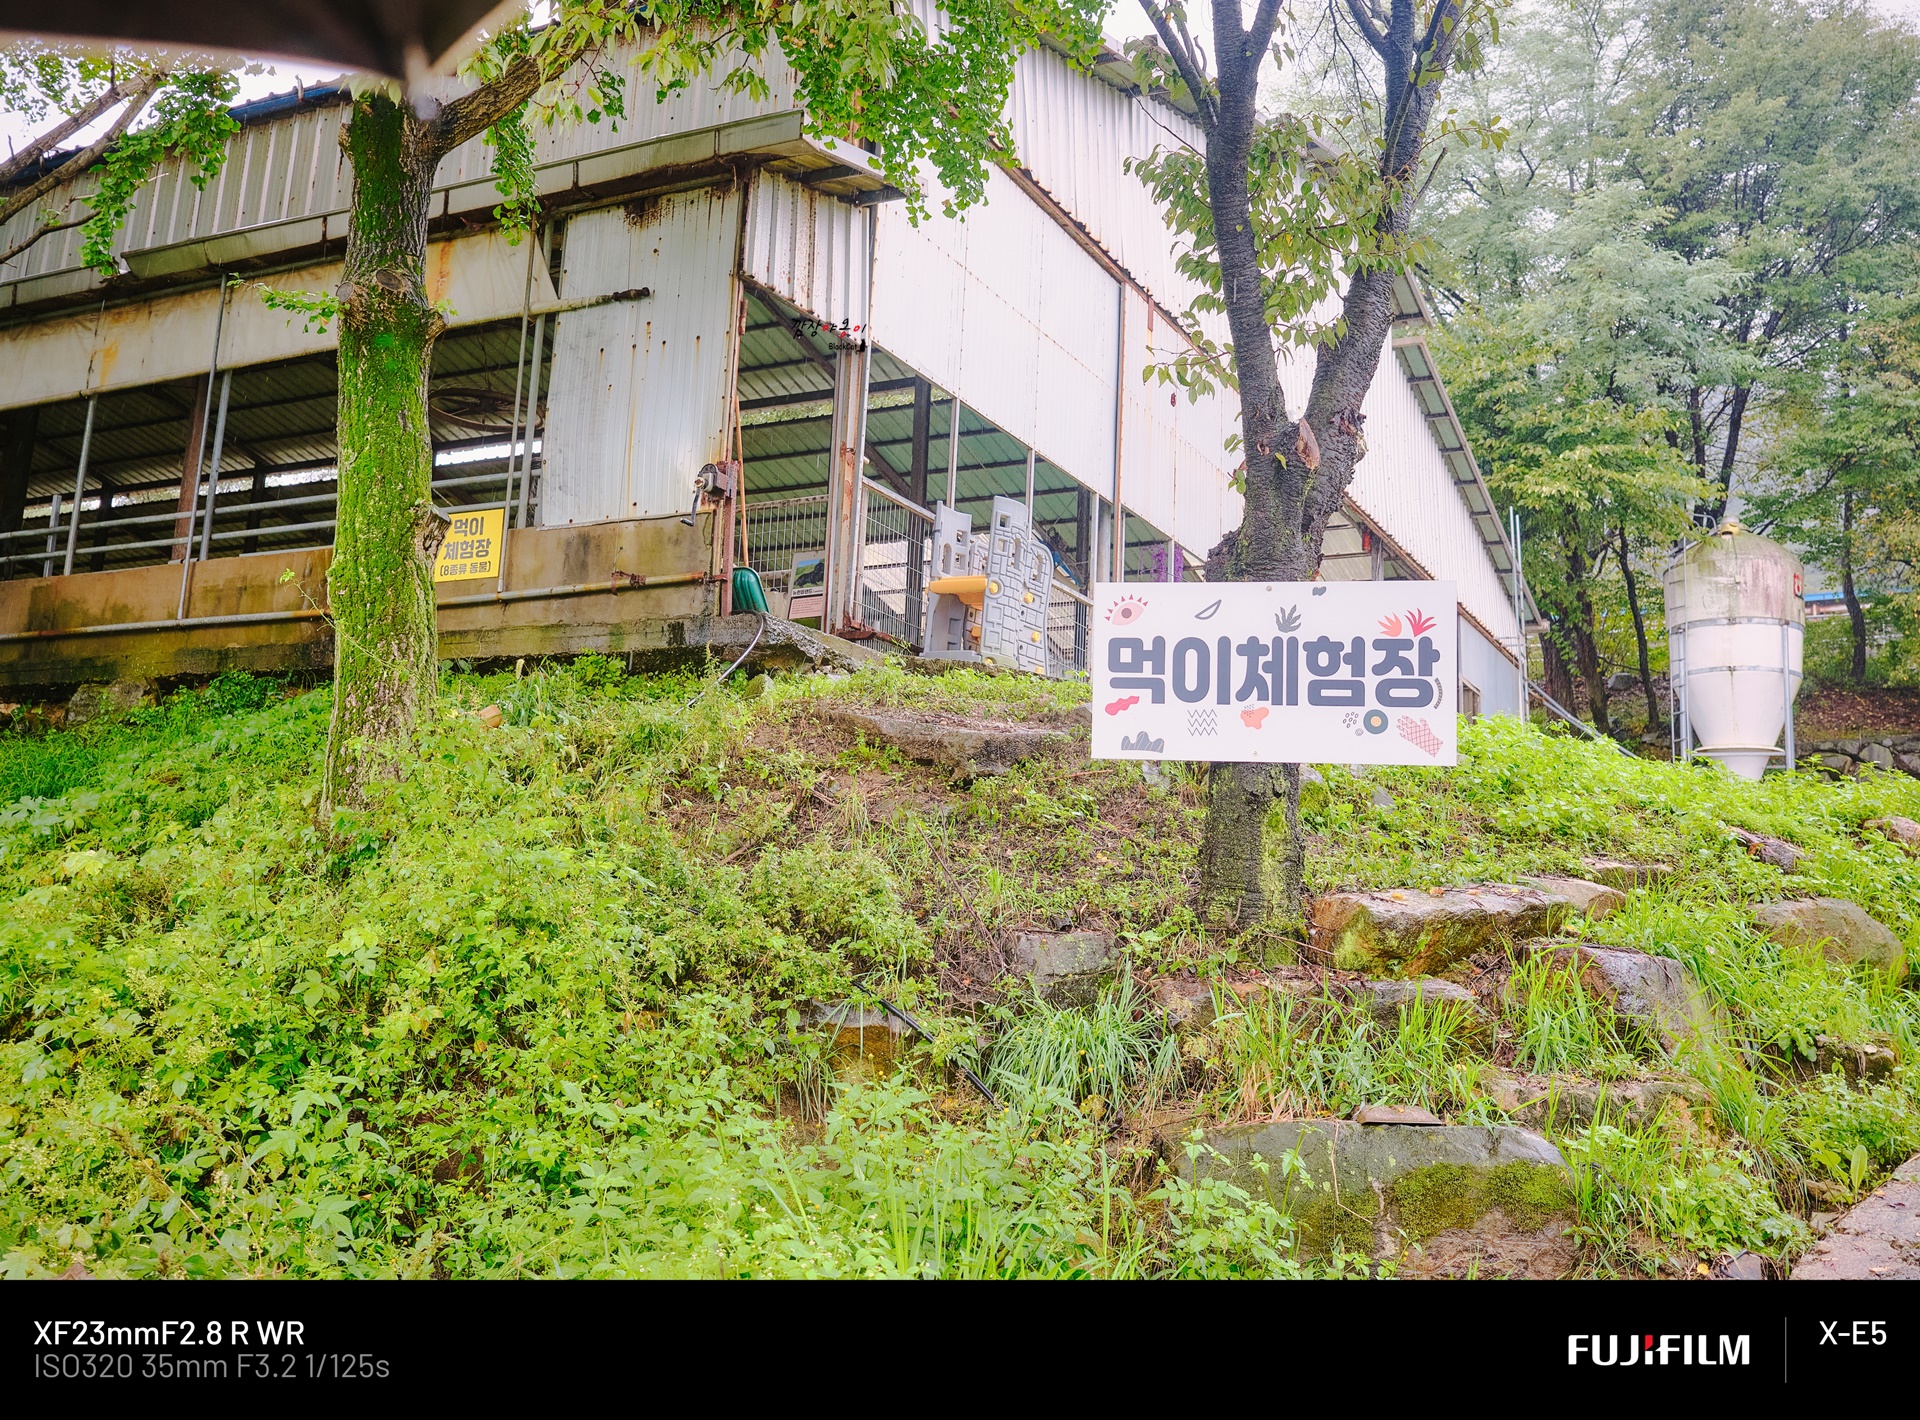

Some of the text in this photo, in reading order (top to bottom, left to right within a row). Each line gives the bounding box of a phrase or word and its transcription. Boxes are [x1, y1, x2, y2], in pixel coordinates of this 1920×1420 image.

[453, 516, 485, 537] 먹이
[443, 538, 492, 560] 체험장
[469, 560, 492, 574] 동물)
[1107, 635, 1441, 708] 먹이체험장
